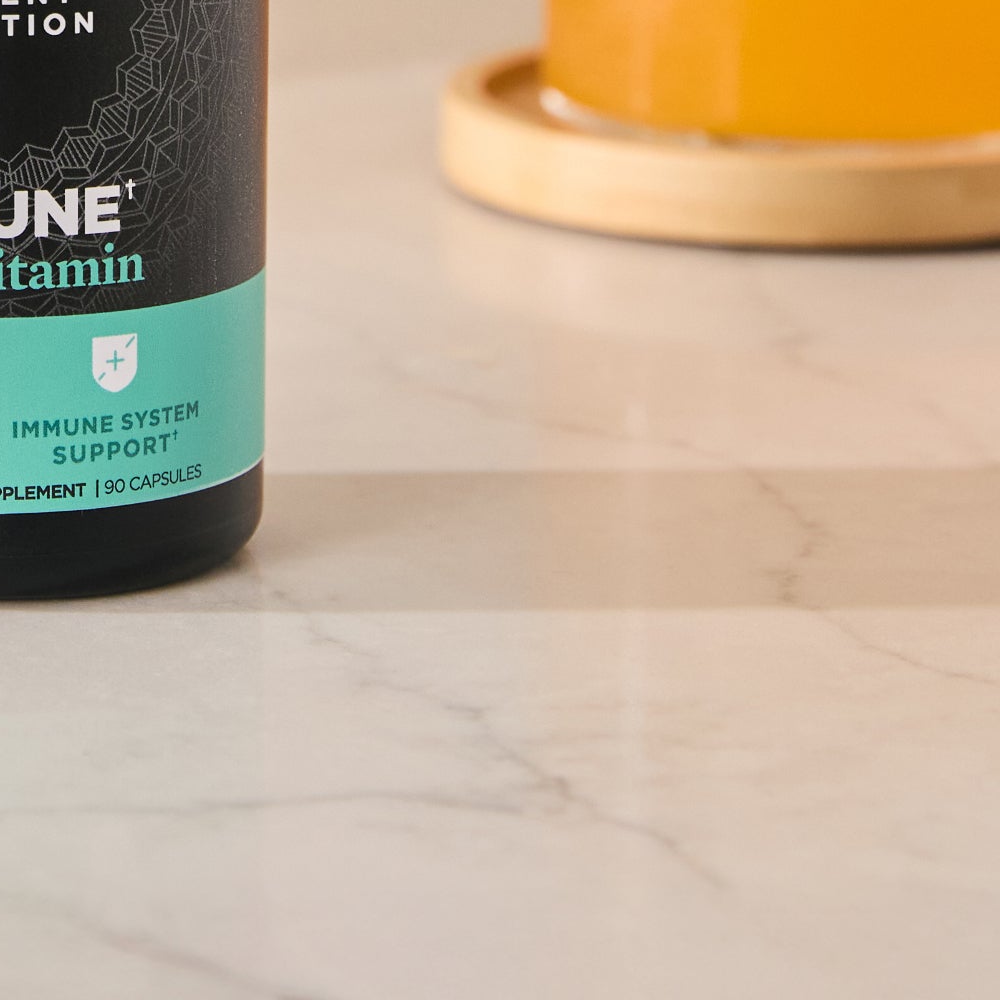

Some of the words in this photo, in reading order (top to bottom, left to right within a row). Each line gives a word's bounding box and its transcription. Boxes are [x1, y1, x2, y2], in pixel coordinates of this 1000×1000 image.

[12, 414, 113, 439] IMMUNE
[121, 400, 200, 432] SYSTEM
[104, 478, 127, 495] 90
[128, 463, 202, 491] CAPSULES
